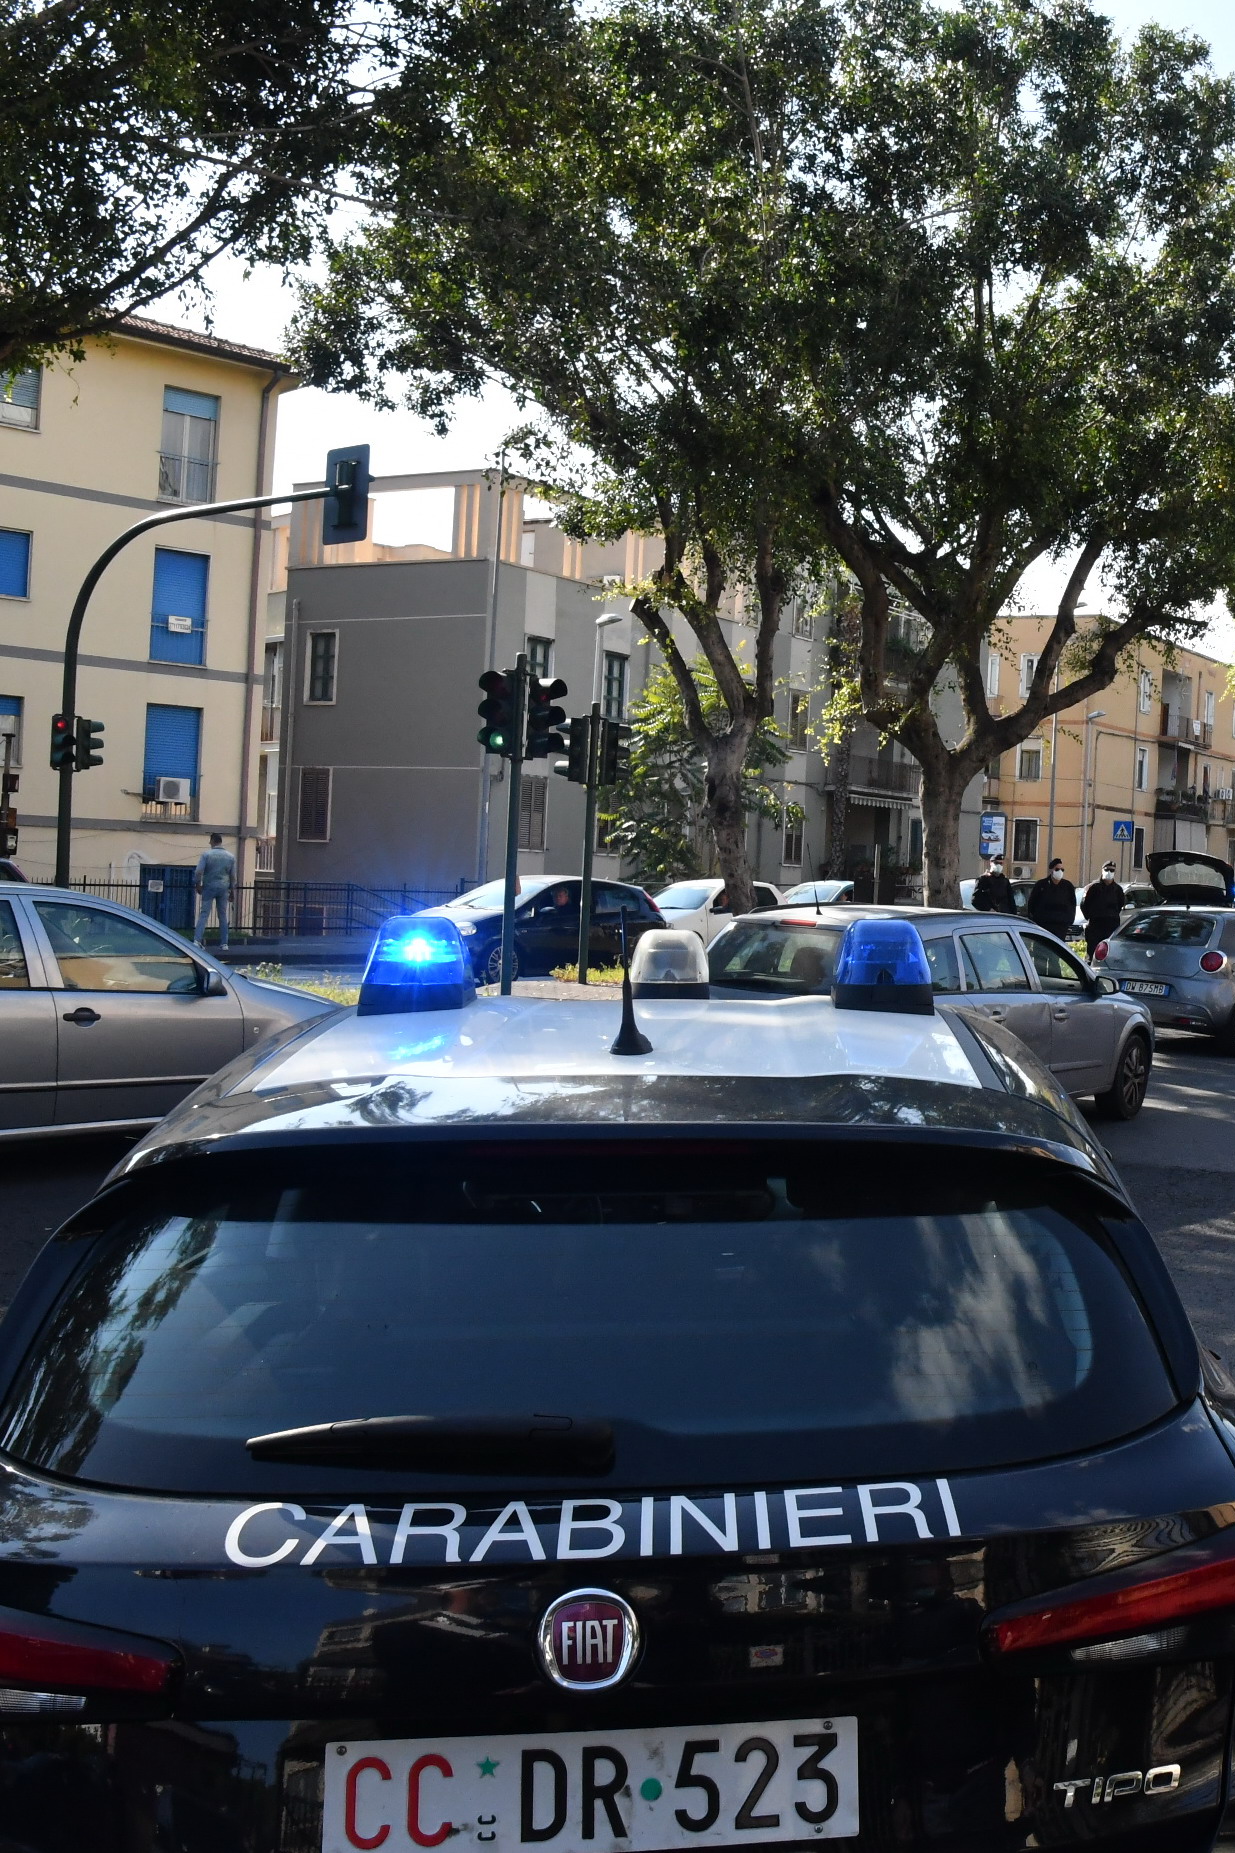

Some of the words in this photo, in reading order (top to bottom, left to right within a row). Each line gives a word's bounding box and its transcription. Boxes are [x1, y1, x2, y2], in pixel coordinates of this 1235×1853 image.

[1126, 981, 1136, 990] DW
[1139, 983, 1163, 994] 875MB
[224, 1478, 964, 1568] CARABINIERI
[561, 1618, 619, 1667] FIAT
[345, 1753, 454, 1850] CC
[520, 1746, 628, 1843] DR
[673, 1732, 838, 1833] 523
[1053, 1763, 1181, 1808] TIPO
